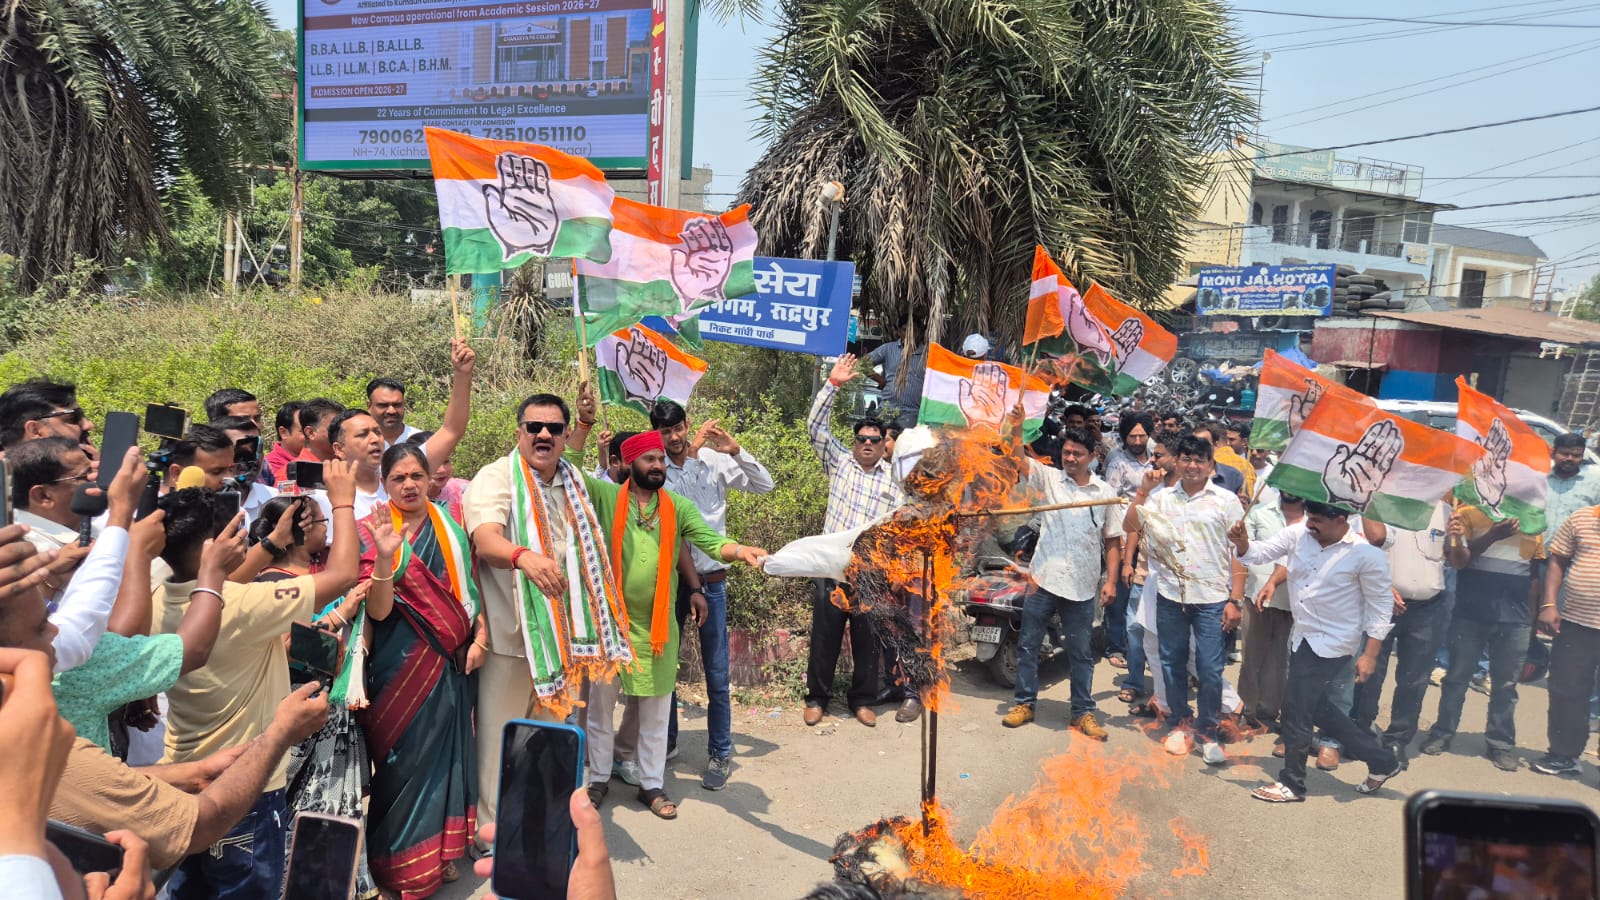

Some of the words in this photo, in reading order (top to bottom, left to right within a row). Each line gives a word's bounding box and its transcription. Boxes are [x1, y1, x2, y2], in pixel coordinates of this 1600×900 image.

[351, 16, 368, 25] New
[370, 14, 404, 24] Campus
[406, 9, 455, 23] operational
[456, 9, 477, 18] from
[479, 5, 526, 17] Academic
[527, 3, 561, 14] Session
[562, 0, 600, 11] 2026-27
[314, 87, 353, 96] ADMISSION
[354, 86, 374, 95] OPEN
[375, 85, 404, 94] 2026-27
[377, 108, 386, 118] 22
[388, 107, 411, 117] Years
[413, 107, 421, 116] of
[423, 105, 477, 116] Commitment
[479, 105, 488, 114] to
[491, 104, 515, 116] Legal
[518, 103, 566, 114] Excellence
[442, 119, 469, 127] CONTACT
[482, 118, 516, 126] ADMISSION
[482, 126, 587, 141] 7351051110
[753, 261, 821, 298] सेरा
[709, 322, 732, 334] निकट
[756, 329, 775, 339] पार्क
[275, 587, 300, 599] 3
